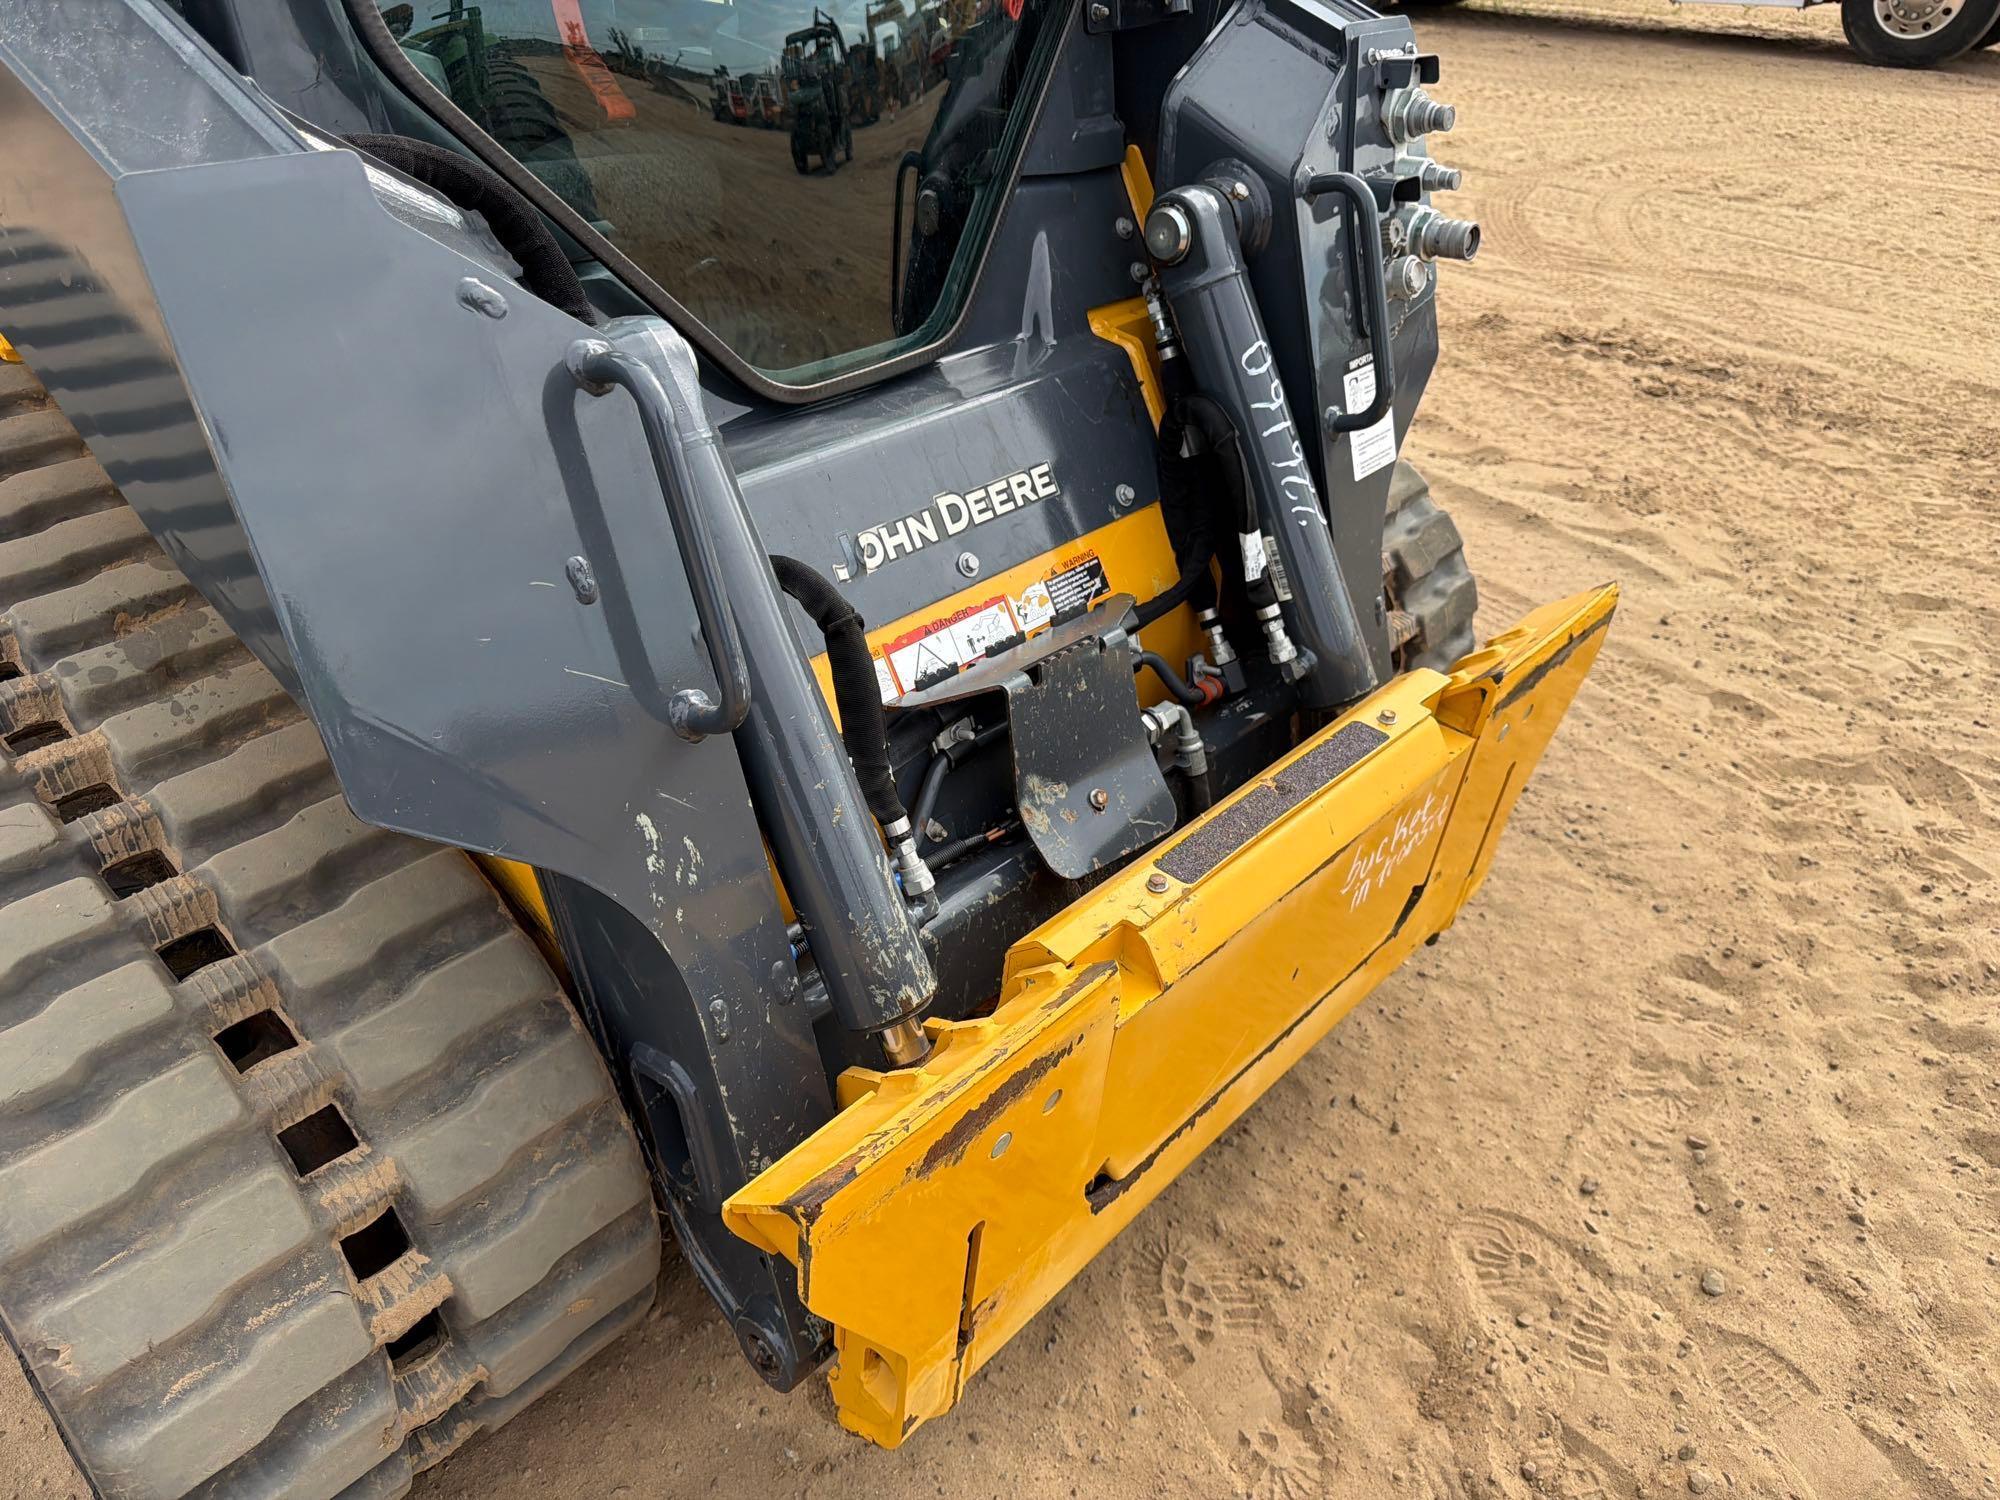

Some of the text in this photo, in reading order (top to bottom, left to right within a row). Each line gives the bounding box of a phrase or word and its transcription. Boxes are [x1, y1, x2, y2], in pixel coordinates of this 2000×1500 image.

[1348, 352, 1373, 370] IMPORTA
[832, 462, 1058, 584] JOHN DEERE
[1061, 548, 1095, 570] WARNING
[932, 608, 969, 632] DANGER
[1350, 878, 1371, 913] in
